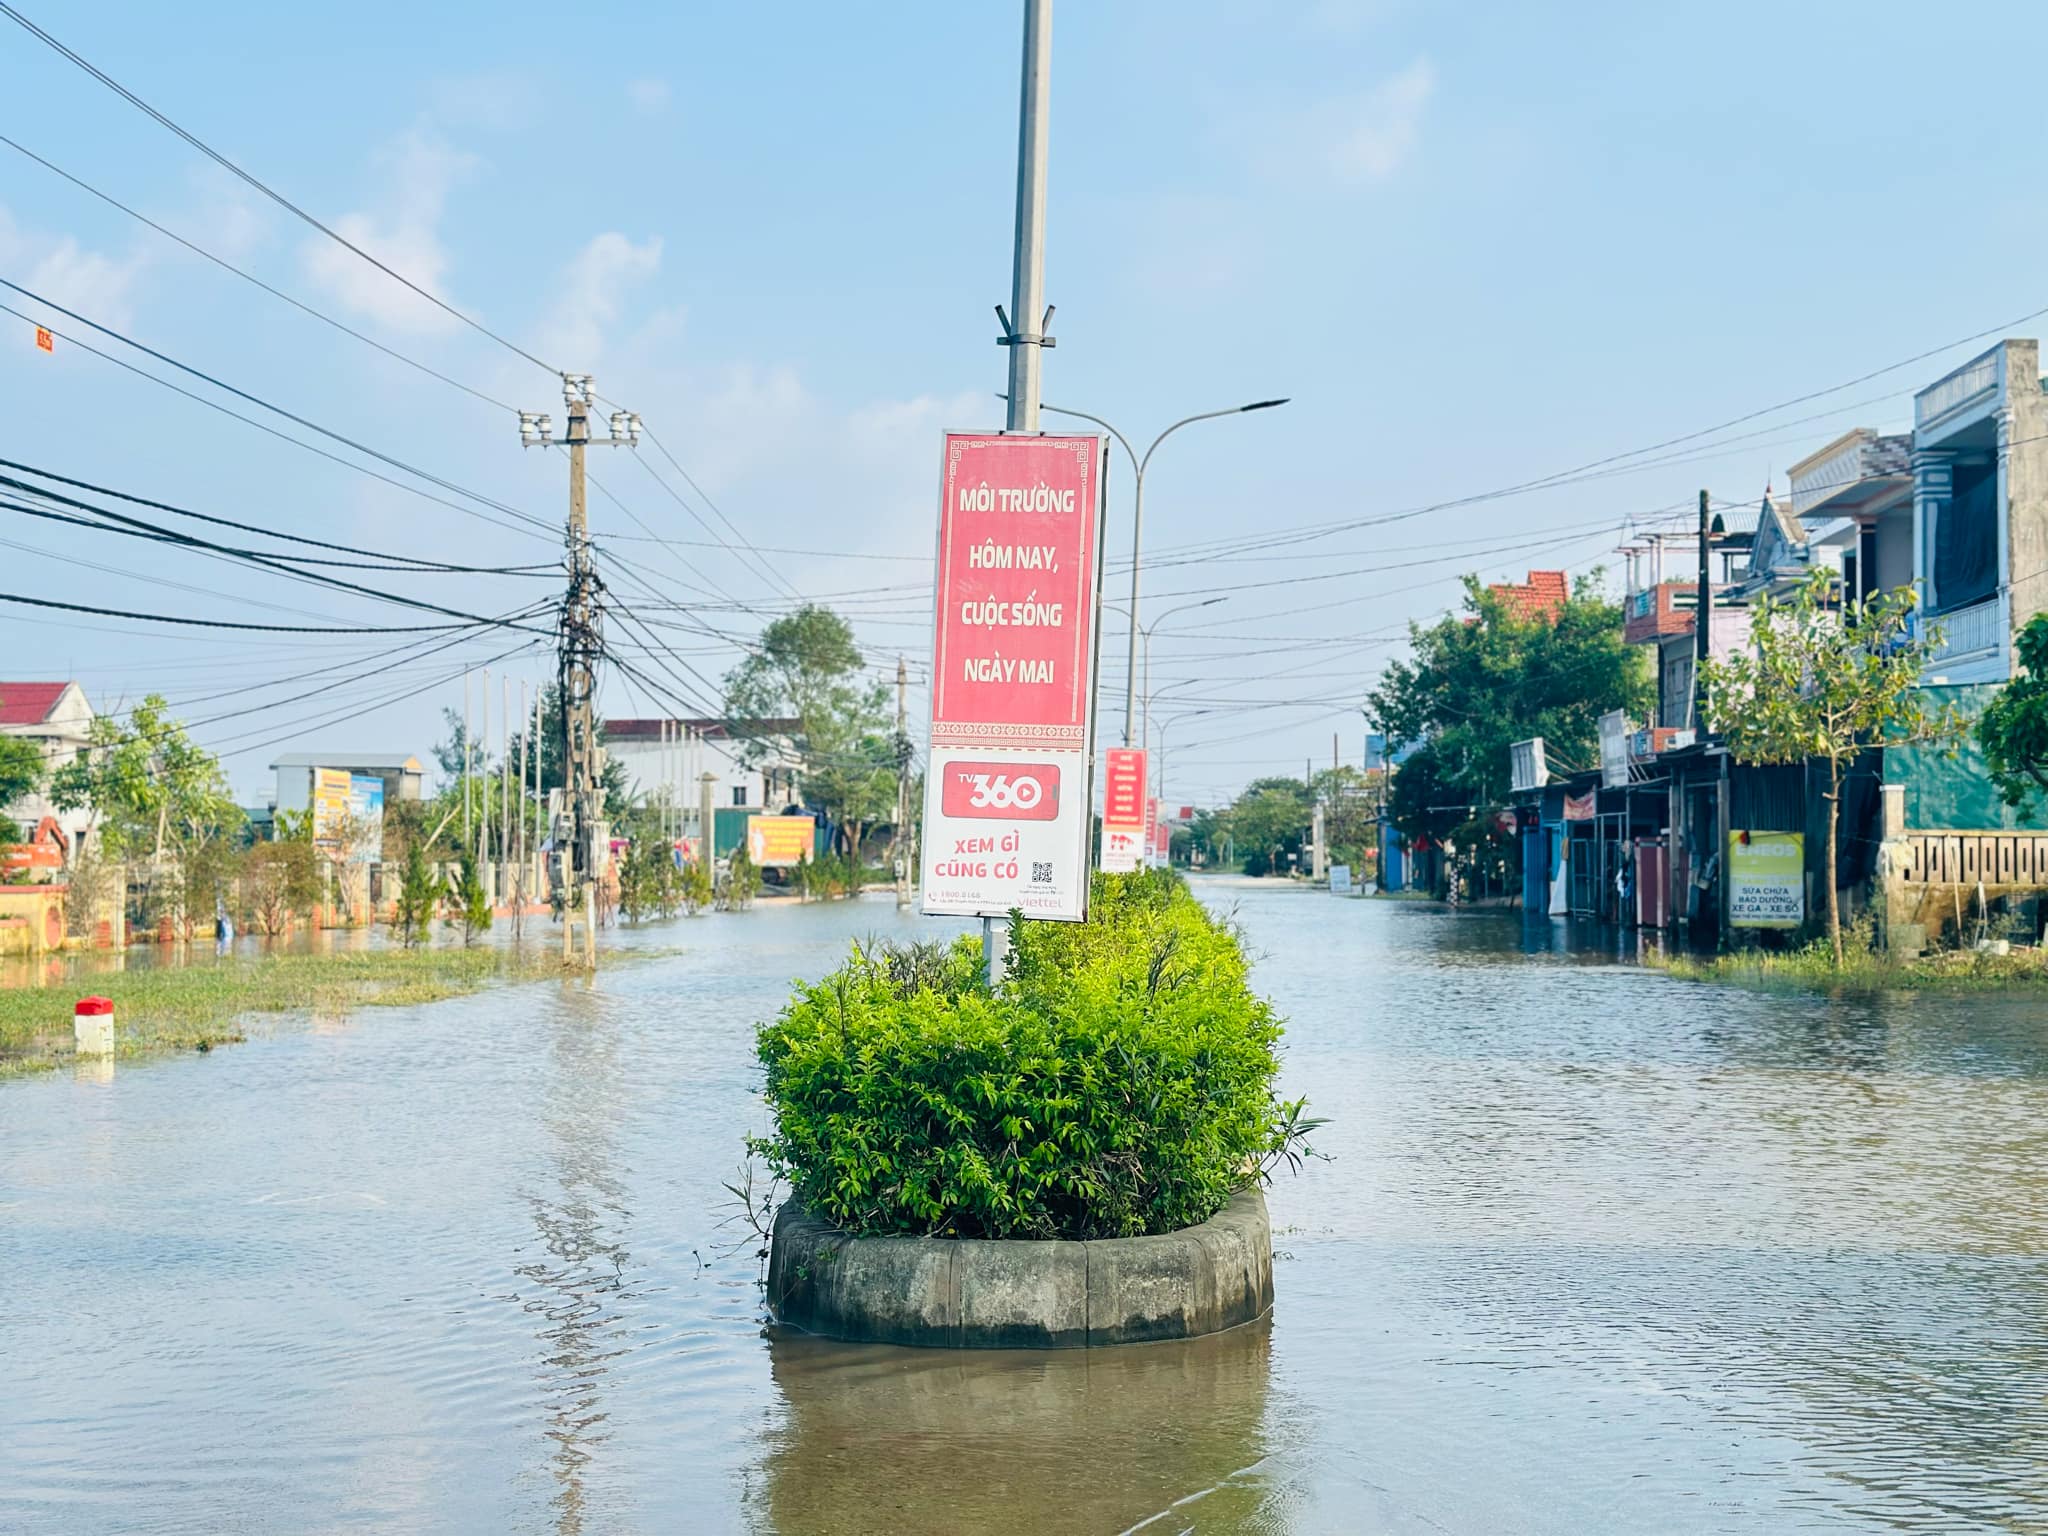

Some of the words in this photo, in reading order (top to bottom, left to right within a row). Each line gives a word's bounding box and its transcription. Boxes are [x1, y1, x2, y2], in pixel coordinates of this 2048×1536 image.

[959, 481, 995, 512] MÔI
[999, 481, 1075, 513] TRƯỜNG
[969, 537, 1012, 569] HÔM
[1015, 546, 1059, 573] NAY,
[961, 594, 1009, 630] CUỘC
[1011, 589, 1063, 627] SỐNG
[964, 651, 1016, 683] NGÀY
[1019, 659, 1055, 684] MAI
[954, 836, 994, 854] XEM
[1001, 829, 1020, 852] GÌ
[935, 859, 987, 878] CŨNG
[993, 857, 1019, 879] CÓ
